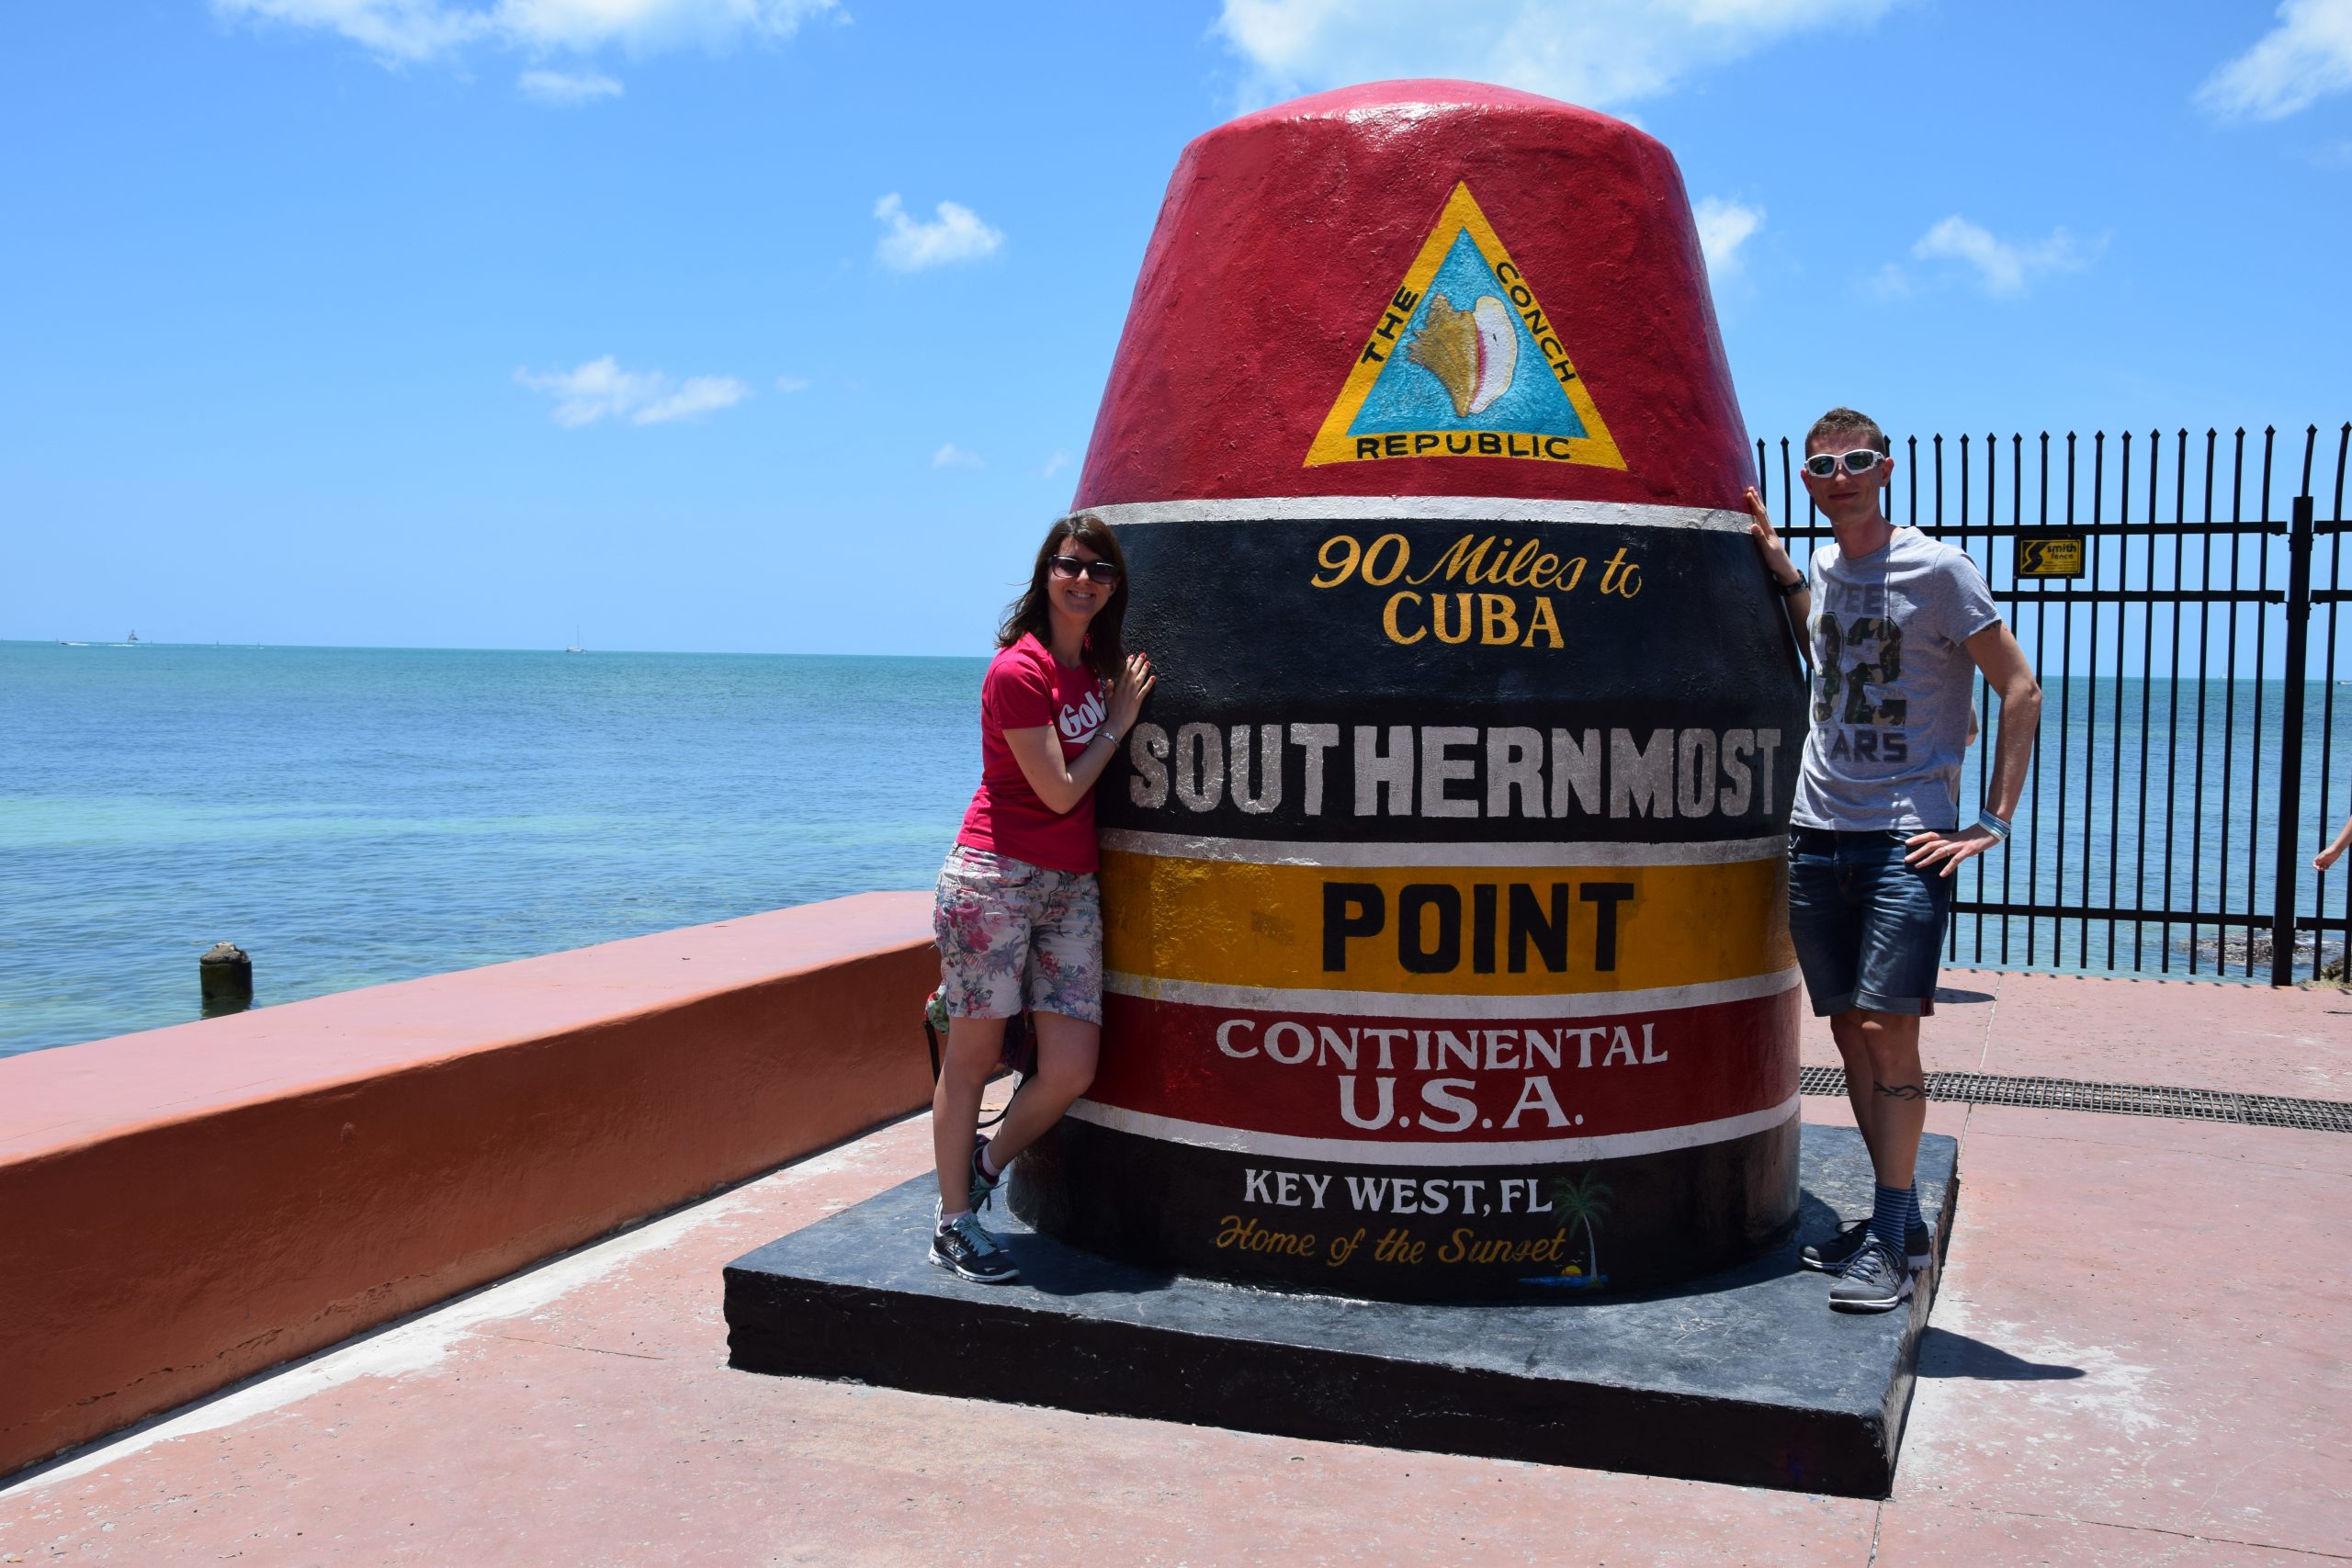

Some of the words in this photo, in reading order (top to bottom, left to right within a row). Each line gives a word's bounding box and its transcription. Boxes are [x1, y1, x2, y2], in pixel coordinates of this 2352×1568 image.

[1361, 286, 1419, 365] THE
[1496, 262, 1577, 382] CONCH
[1356, 433, 1571, 460] REPUBLIC
[1311, 533, 1410, 589] 90
[1405, 534, 1588, 592] Miles
[1600, 547, 1642, 598] to
[1383, 590, 1565, 649] CUBA
[1128, 721, 1781, 819] SOUTHERNMOST
[1322, 881, 1634, 975] POINT
[1216, 1019, 1668, 1071] CONTINENTAL
[1337, 1075, 1584, 1133] U.S.A.
[1243, 1168, 1333, 1210] KEY
[1499, 1179, 1554, 1213] FL
[1216, 1214, 1316, 1258] Home
[1327, 1227, 1367, 1267] of
[1374, 1227, 1425, 1265] the
[1438, 1227, 1566, 1265] Sunset
